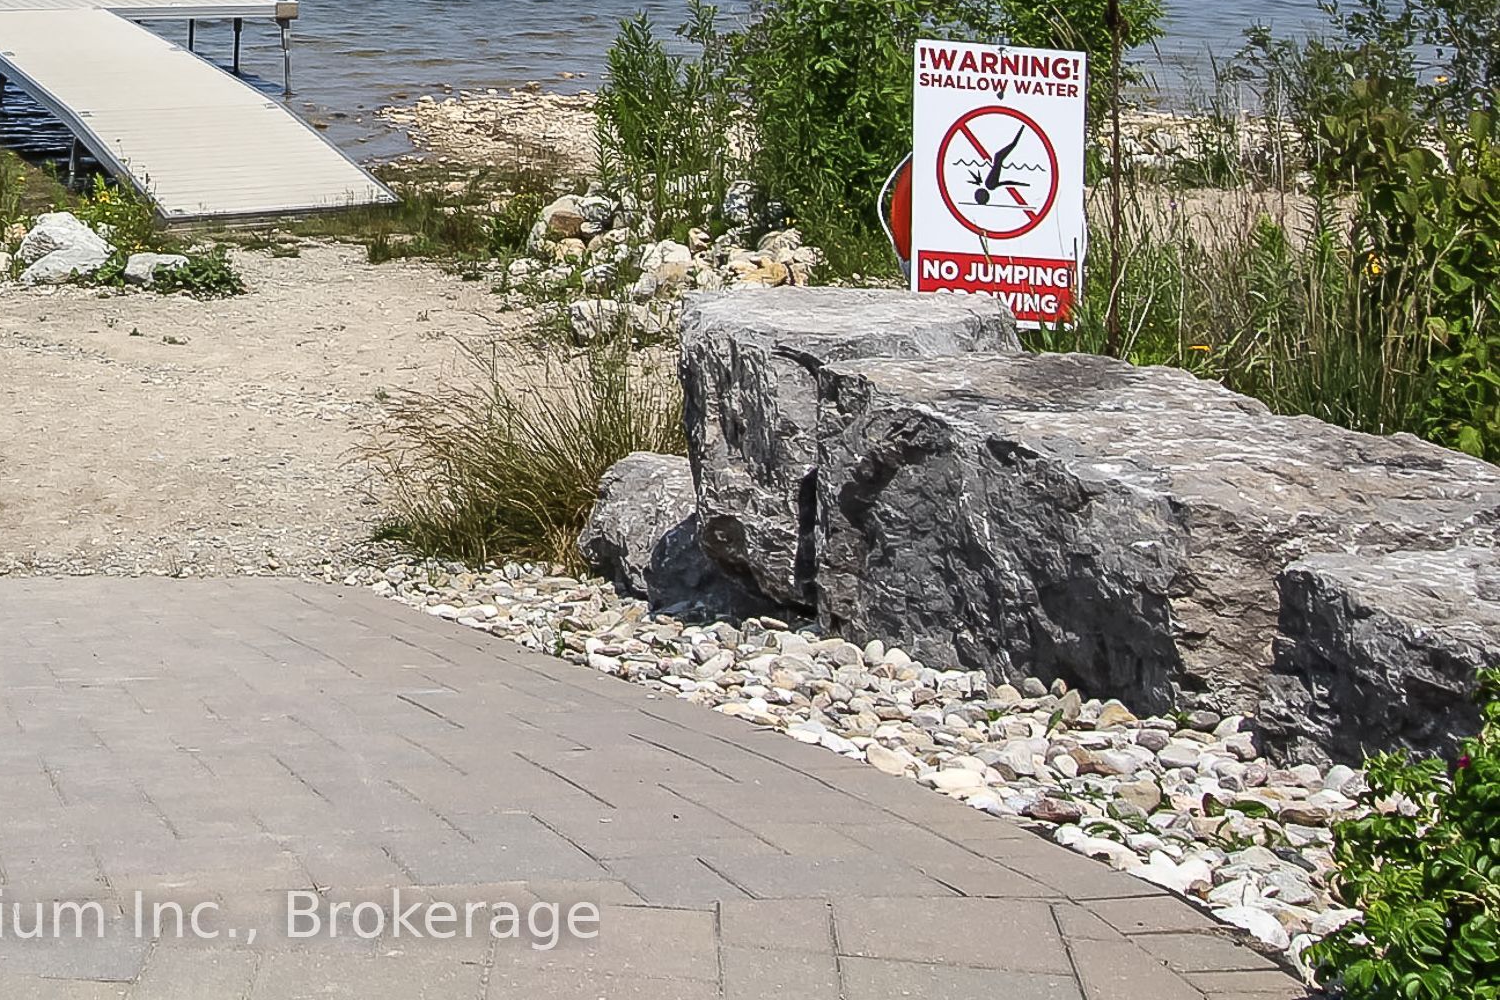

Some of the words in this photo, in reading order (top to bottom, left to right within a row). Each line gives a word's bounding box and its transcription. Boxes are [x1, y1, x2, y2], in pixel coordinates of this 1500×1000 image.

[920, 47, 1079, 80] !WARNING!
[919, 72, 1008, 92] SHALLOW
[1014, 79, 1078, 97] WATER
[922, 259, 959, 280] NO
[964, 262, 1068, 288] JUMPING
